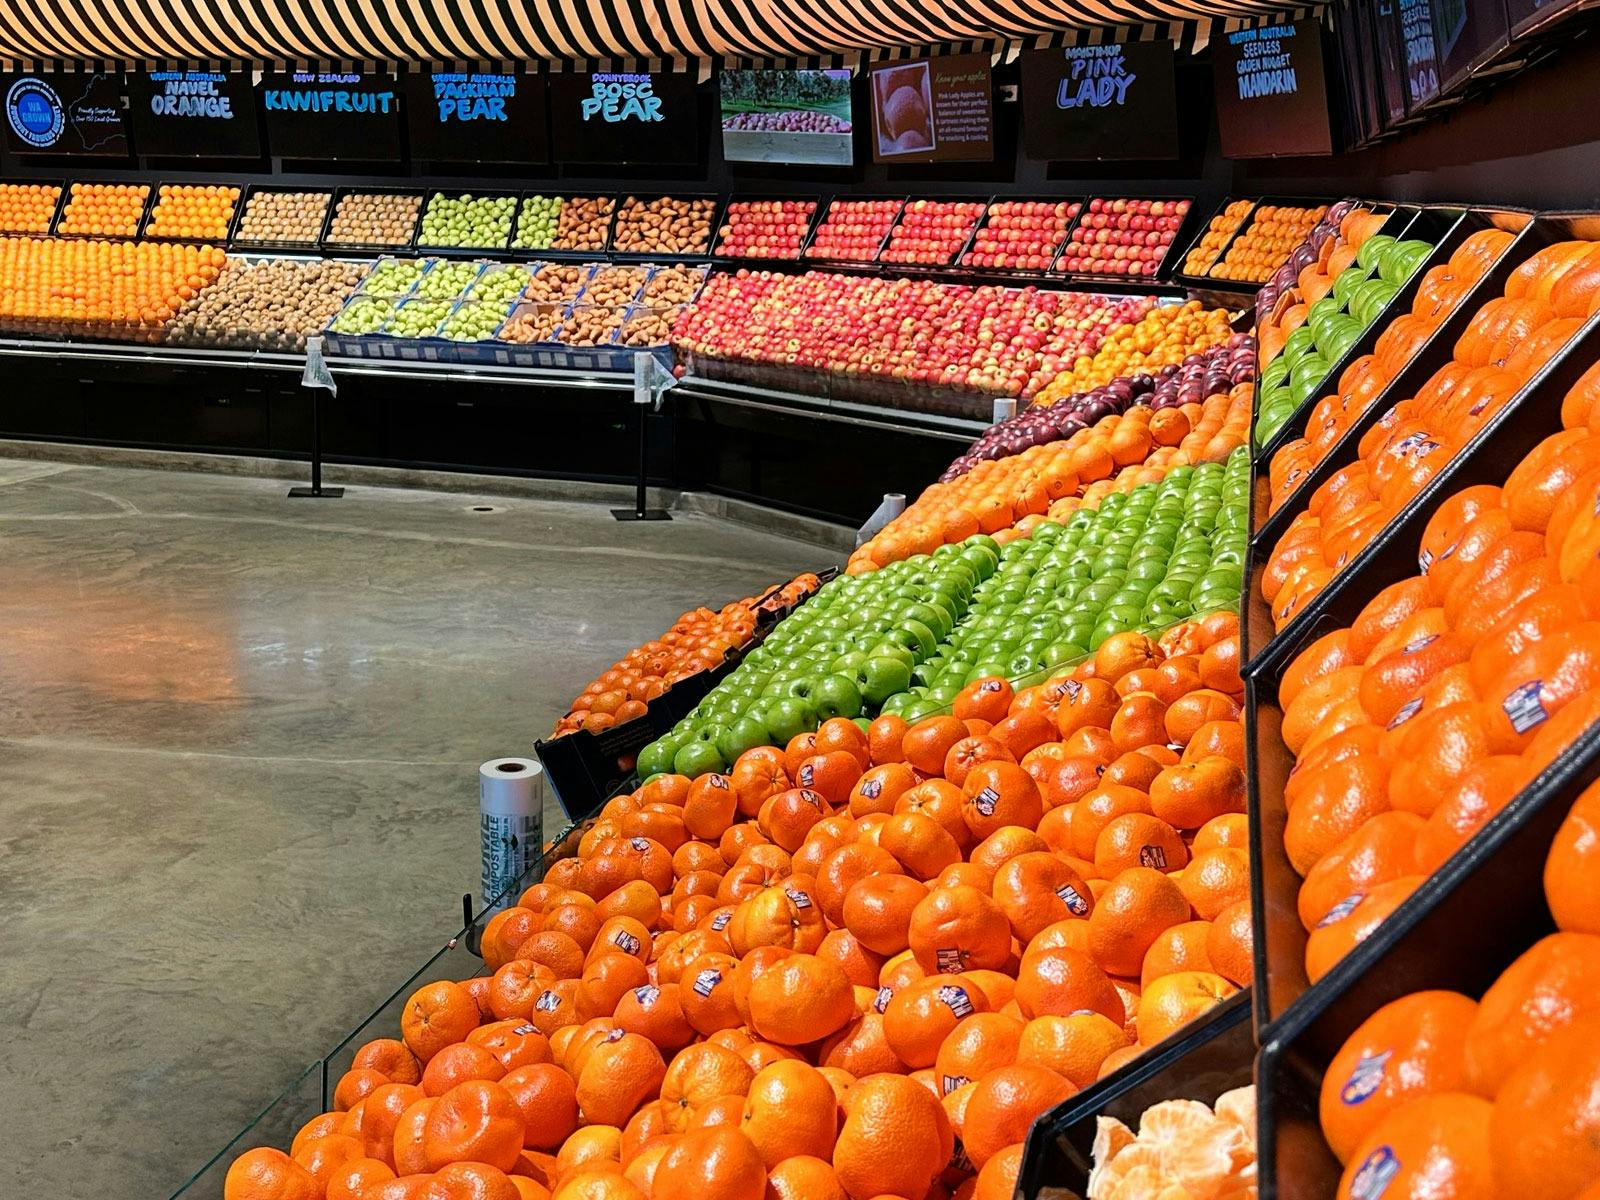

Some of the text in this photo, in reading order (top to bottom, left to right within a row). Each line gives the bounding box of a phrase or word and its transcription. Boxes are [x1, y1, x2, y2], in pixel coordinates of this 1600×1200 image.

[1259, 25, 1296, 40] AUSTRALIA
[1243, 40, 1281, 58] SEEDLESS
[1071, 56, 1127, 80] PINK
[1236, 53, 1291, 75] GOLDEN NUGGET
[165, 81, 219, 96] NAVEL
[293, 74, 360, 83] NEW ZEALAND
[592, 73, 651, 82] DONNYBROOK
[1238, 68, 1298, 100] MANDARIN
[434, 82, 515, 99] PACKHAM
[592, 83, 654, 100] BOSC
[1057, 73, 1136, 109] LADY
[27, 101, 42, 113] WA
[151, 95, 234, 119] ORANGE
[264, 90, 394, 114] KIWIFRUIT
[438, 98, 508, 122] PEAR
[581, 97, 665, 122] PEAR
[489, 815, 502, 908] COMPOSTABLE
